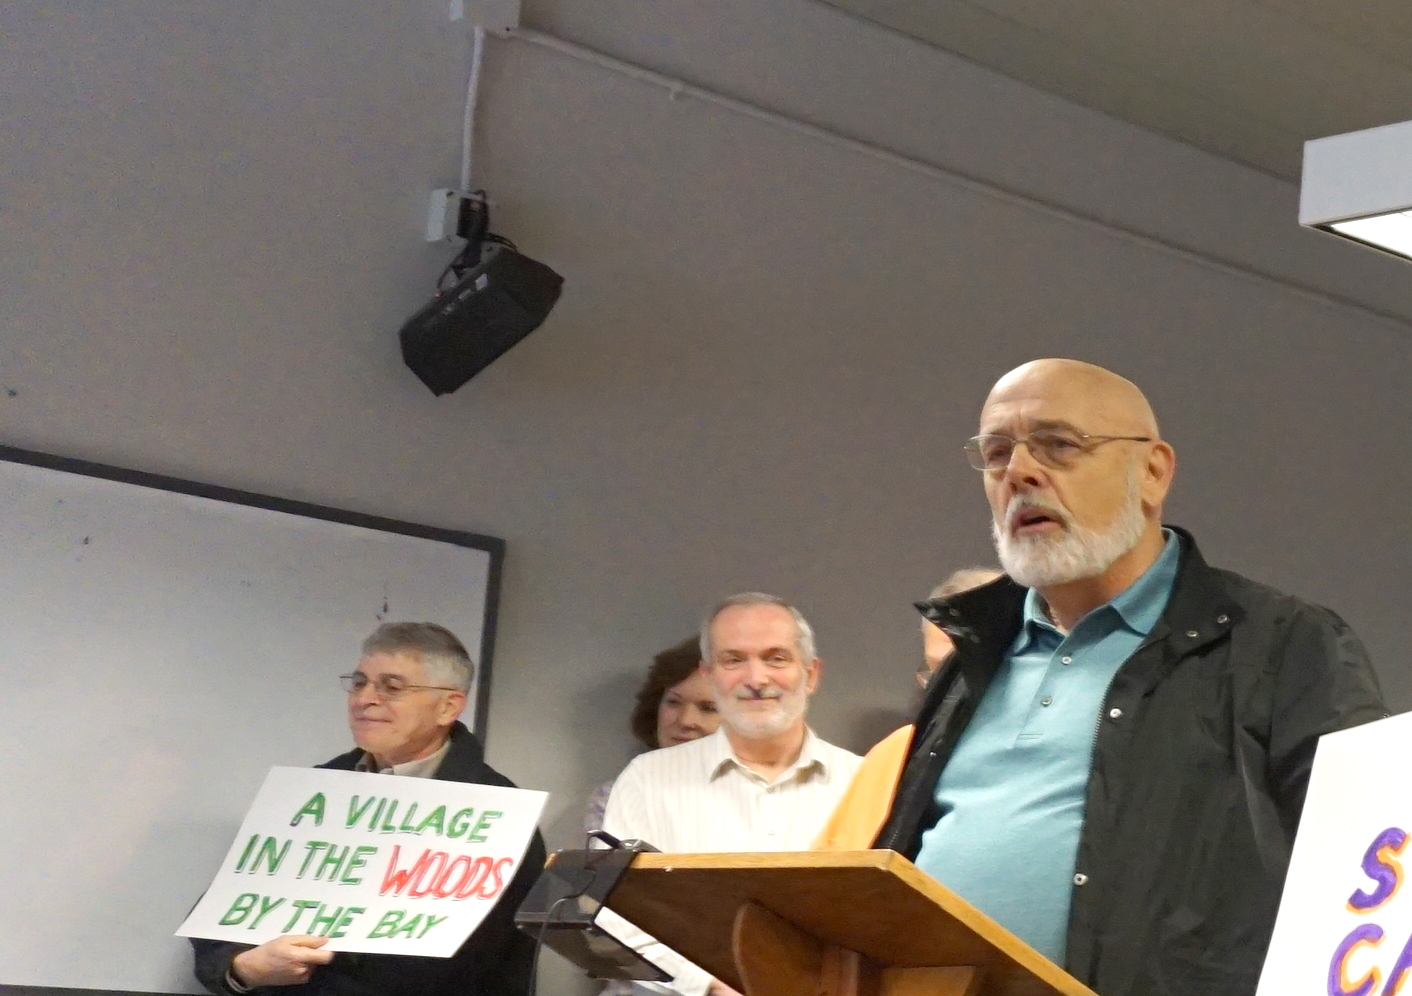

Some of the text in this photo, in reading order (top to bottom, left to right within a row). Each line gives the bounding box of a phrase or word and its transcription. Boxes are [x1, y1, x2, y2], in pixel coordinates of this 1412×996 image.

[290, 792, 503, 843] A VILLAGE
[233, 833, 514, 901] IN THE WOODS
[218, 893, 450, 941] BY THE BAY
